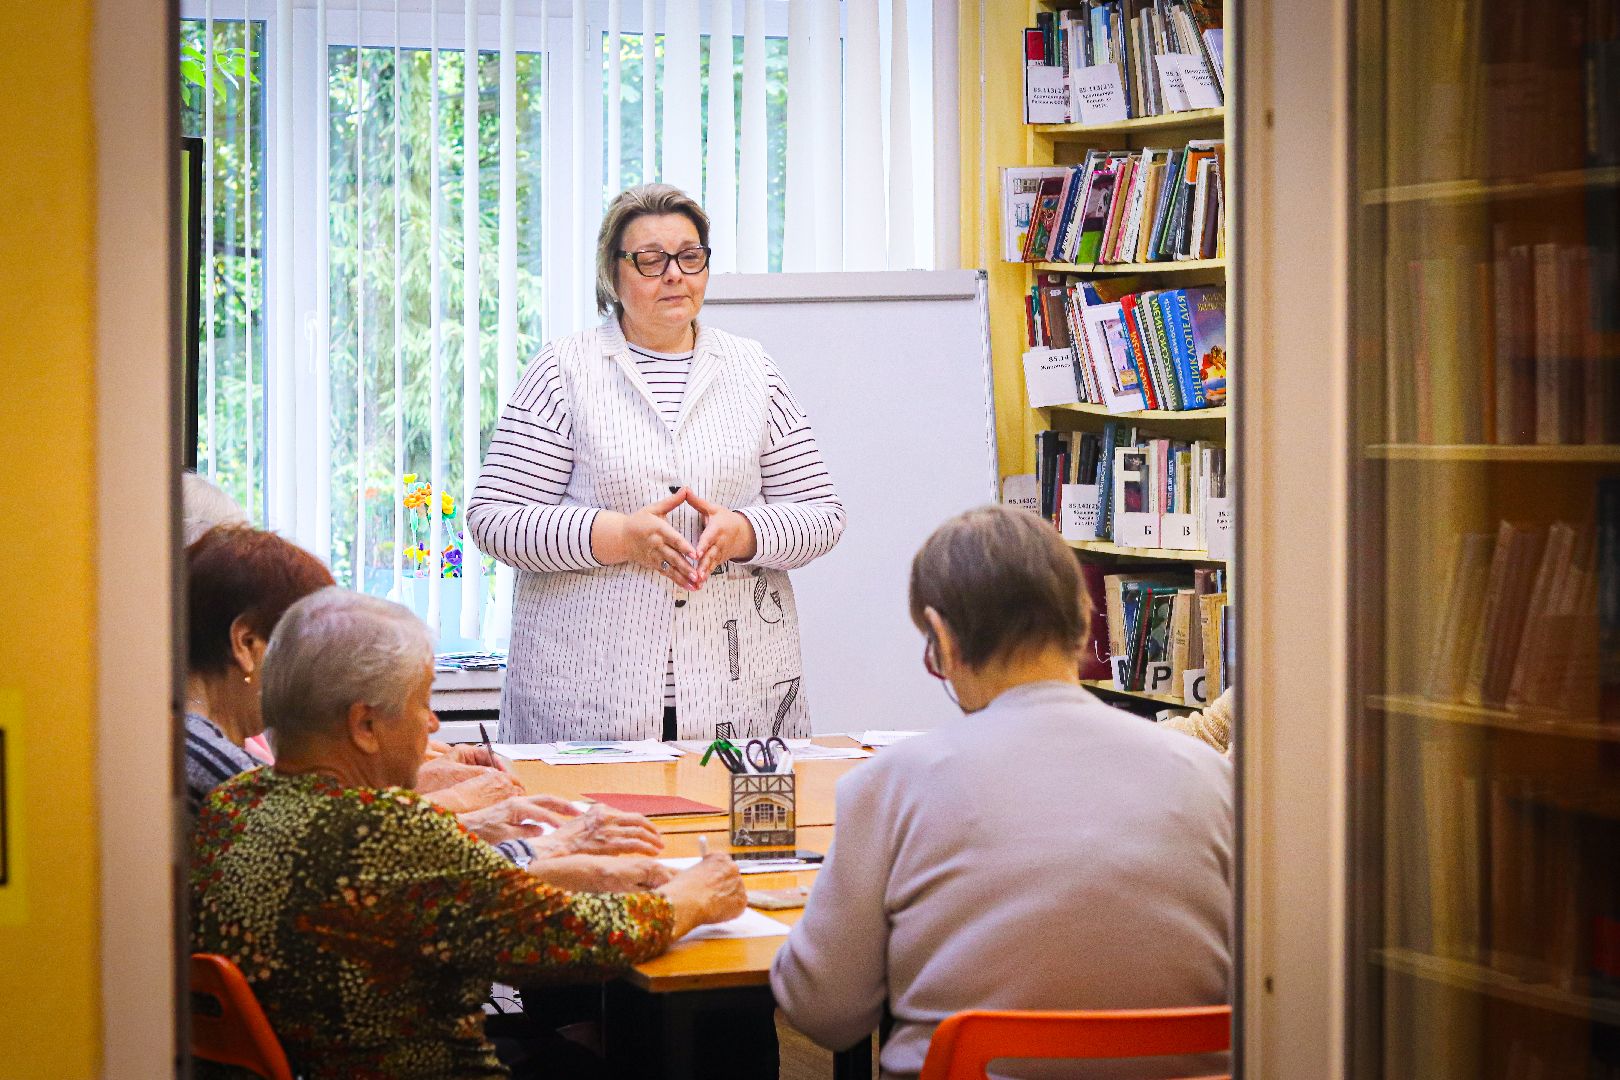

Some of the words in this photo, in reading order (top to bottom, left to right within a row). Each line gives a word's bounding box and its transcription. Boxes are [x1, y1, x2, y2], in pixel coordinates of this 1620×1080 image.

[1151, 298, 1177, 406] ИМПРЕССИОНИЗМ
[1177, 295, 1205, 404] ЭНЦИКЛОПЕДИЯ
[1183, 526, 1191, 536] В
[1152, 666, 1172, 690] Р
